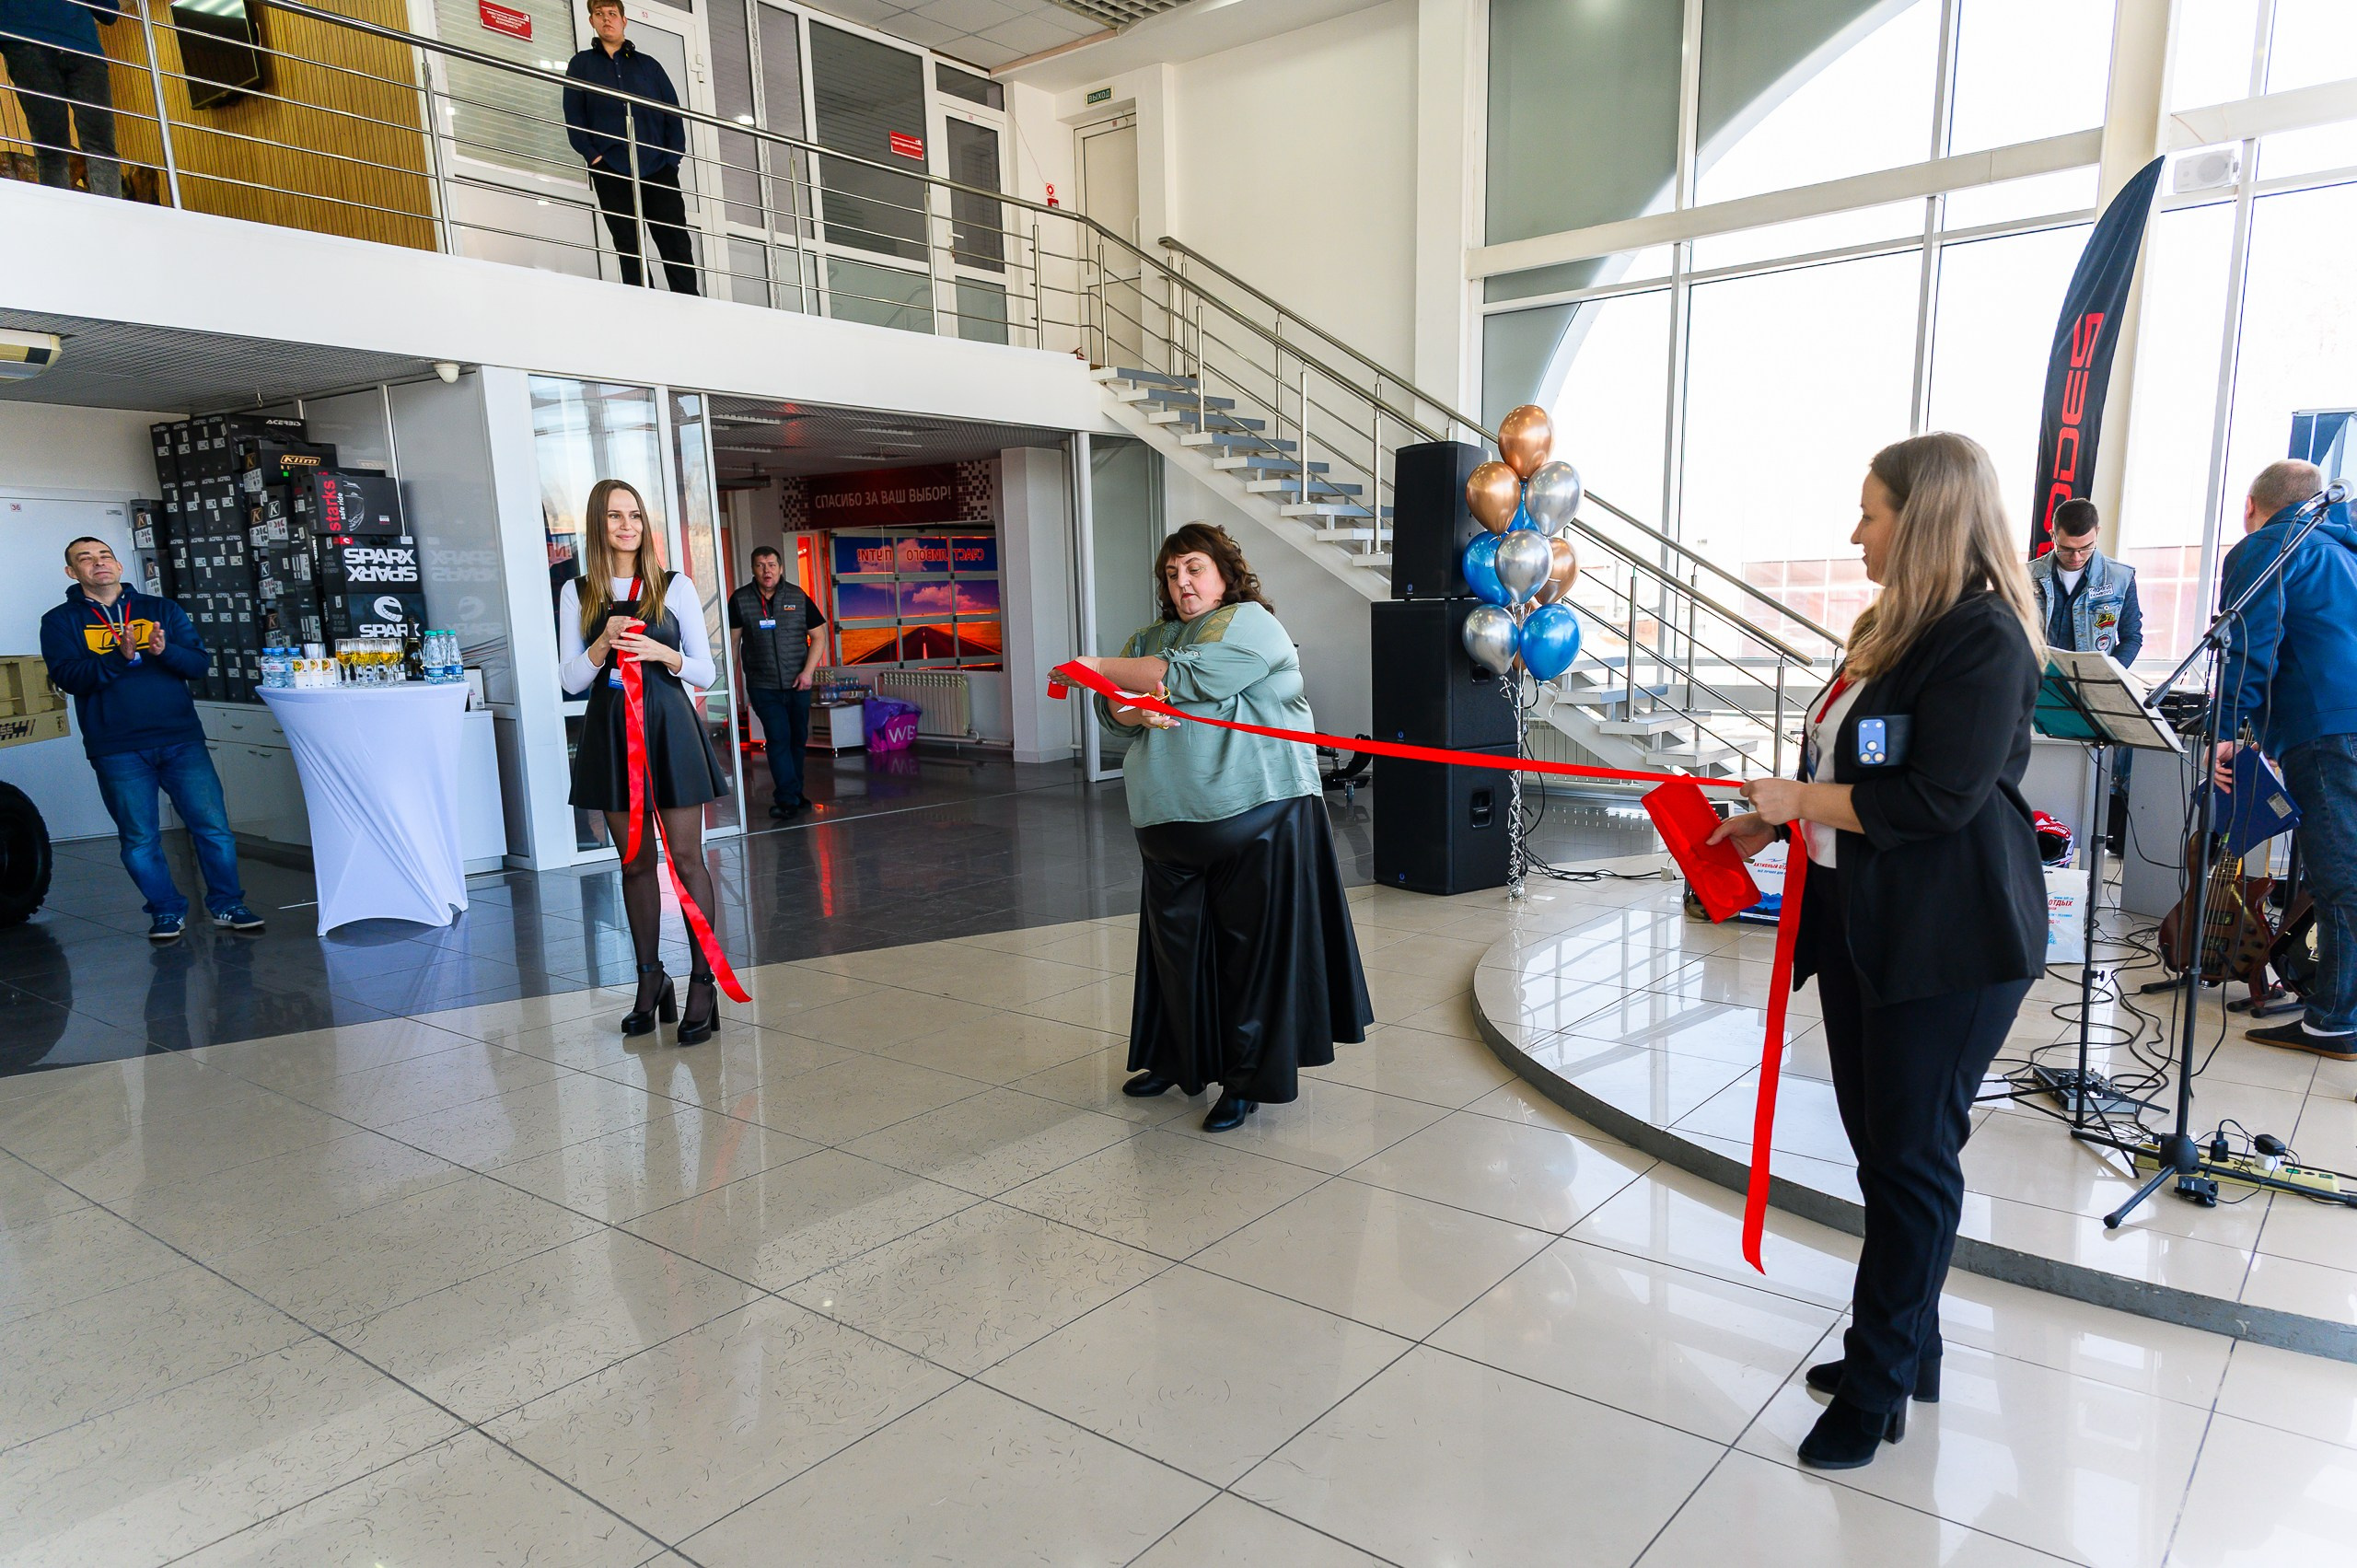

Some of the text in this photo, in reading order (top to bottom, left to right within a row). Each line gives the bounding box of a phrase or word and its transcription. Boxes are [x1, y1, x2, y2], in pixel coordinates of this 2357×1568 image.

[1088, 89, 1110, 103] ВЫХОД
[2037, 312, 2105, 559] ODES
[321, 480, 342, 531] starks
[815, 485, 951, 508] СПАСИБО ЗА ВАШ ВЫБОР!
[343, 548, 416, 564] SPARX
